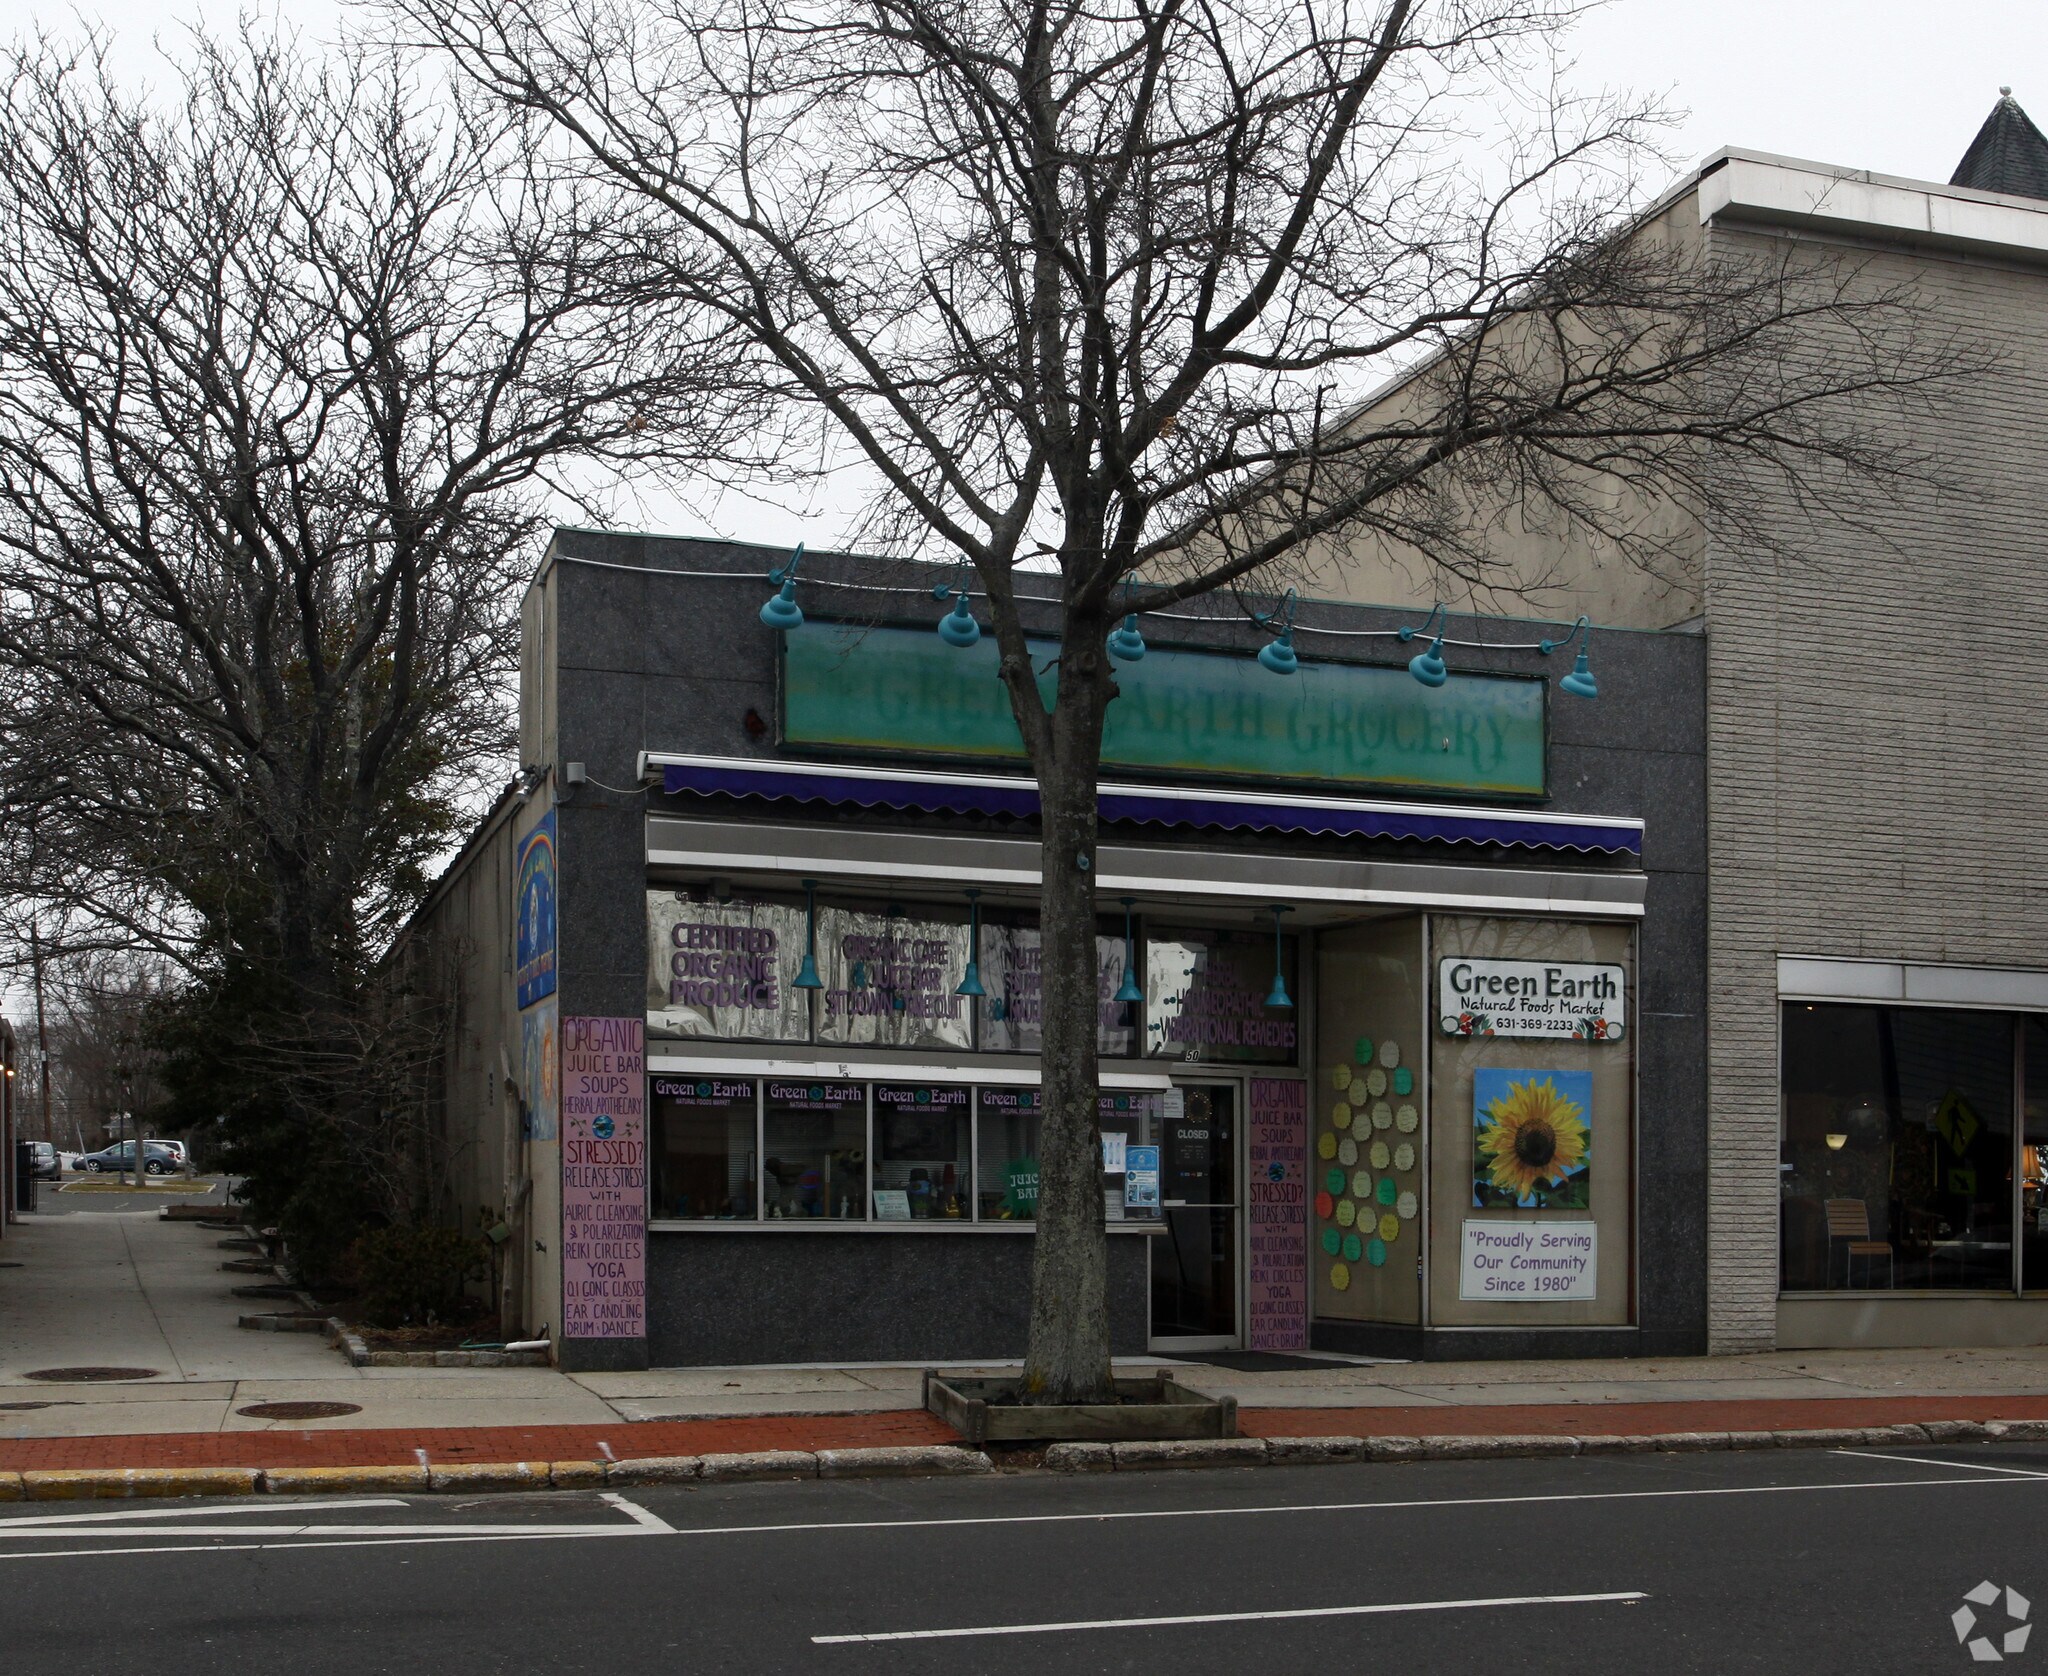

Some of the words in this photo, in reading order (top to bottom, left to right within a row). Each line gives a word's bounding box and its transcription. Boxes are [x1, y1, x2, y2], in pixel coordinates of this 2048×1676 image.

[1286, 692, 1513, 776] GROCERY
[671, 922, 776, 953] CERTIFIED
[842, 934, 911, 963] ORGANIC
[671, 950, 777, 983] ORGANIC
[869, 963, 911, 991] JUICE
[911, 966, 942, 991] BAR
[1451, 964, 1538, 996] Green
[1544, 968, 1617, 999] Earth
[670, 979, 779, 1010] PRODUCE
[825, 990, 847, 1016] SIT
[848, 990, 893, 1016] DOWN
[904, 995, 932, 1019] TAKE
[933, 996, 964, 1020] OUT
[1181, 990, 1265, 1018] HOMEOPATHIC
[1461, 996, 1516, 1012] Natural
[1520, 998, 1554, 1013] Foods
[1560, 999, 1605, 1015] Market
[1162, 1017, 1240, 1045] VIBRATIONAL
[1242, 1020, 1297, 1048] REMEDIES
[1496, 1018, 1573, 1031] 631-369-2233
[565, 1019, 643, 1053] ORGANIC
[567, 1055, 611, 1073] JUICE
[618, 1056, 642, 1073] BAR
[1186, 1050, 1200, 1062] 50
[580, 1077, 629, 1094] SOUPS
[656, 1080, 695, 1096] Green
[712, 1082, 750, 1098] Earth
[770, 1083, 808, 1100] Green
[825, 1085, 862, 1101] Earth
[879, 1087, 915, 1102] Green
[931, 1089, 966, 1104] Earth
[983, 1091, 1017, 1106] Green
[1250, 1080, 1305, 1109] ORGANIC
[565, 1096, 598, 1114] HERBAL
[597, 1096, 641, 1115] APOTHECARY
[1252, 1111, 1280, 1126] JUICE
[1284, 1112, 1303, 1126] BAR
[1177, 1129, 1209, 1139] CLOSED
[1261, 1129, 1293, 1143] SOUPS
[567, 1141, 643, 1165] STRESSED?
[565, 1167, 610, 1188] RELEASE
[612, 1167, 644, 1188] STRESS
[1010, 1174, 1039, 1187] JUIC
[590, 1191, 621, 1201] WITH
[1250, 1183, 1304, 1203] STRESSED?
[565, 1205, 593, 1221] AURIC
[596, 1205, 643, 1222] CLEANSING
[1250, 1205, 1280, 1224] RELEASE
[1281, 1206, 1305, 1225] STRESS
[569, 1225, 578, 1240] &
[583, 1224, 644, 1240] POLARIZATION
[1265, 1225, 1287, 1233] WITH
[1267, 1237, 1303, 1251] CLEANSING
[1469, 1231, 1533, 1252] "Proudly
[1540, 1234, 1591, 1252] Serving
[566, 1243, 590, 1259] REIKI
[594, 1243, 640, 1259] CIRCLES
[1262, 1254, 1304, 1267] POLARIZATION
[1474, 1255, 1503, 1269] Our
[1510, 1255, 1587, 1273] Community
[587, 1263, 626, 1278] YOGA
[1251, 1269, 1268, 1283] REIKI
[1272, 1269, 1304, 1283] CIRCLES
[567, 1281, 579, 1297] QI
[583, 1281, 609, 1297] GONG
[613, 1281, 644, 1298] CLASSES
[1266, 1285, 1291, 1299] YOGA
[1484, 1278, 1525, 1292] Since
[1534, 1277, 1576, 1292] 1980"
[566, 1304, 588, 1319] EAR
[593, 1304, 641, 1319] CANDLING
[1260, 1302, 1277, 1315] GONG
[1278, 1302, 1304, 1315] CLASSES
[567, 1321, 594, 1336] DRUM
[602, 1321, 639, 1336] DANCE
[1251, 1317, 1267, 1331] EAR
[1268, 1317, 1304, 1331] CANDLING
[1251, 1333, 1276, 1348] DANCE
[1280, 1334, 1304, 1349] DRUM
